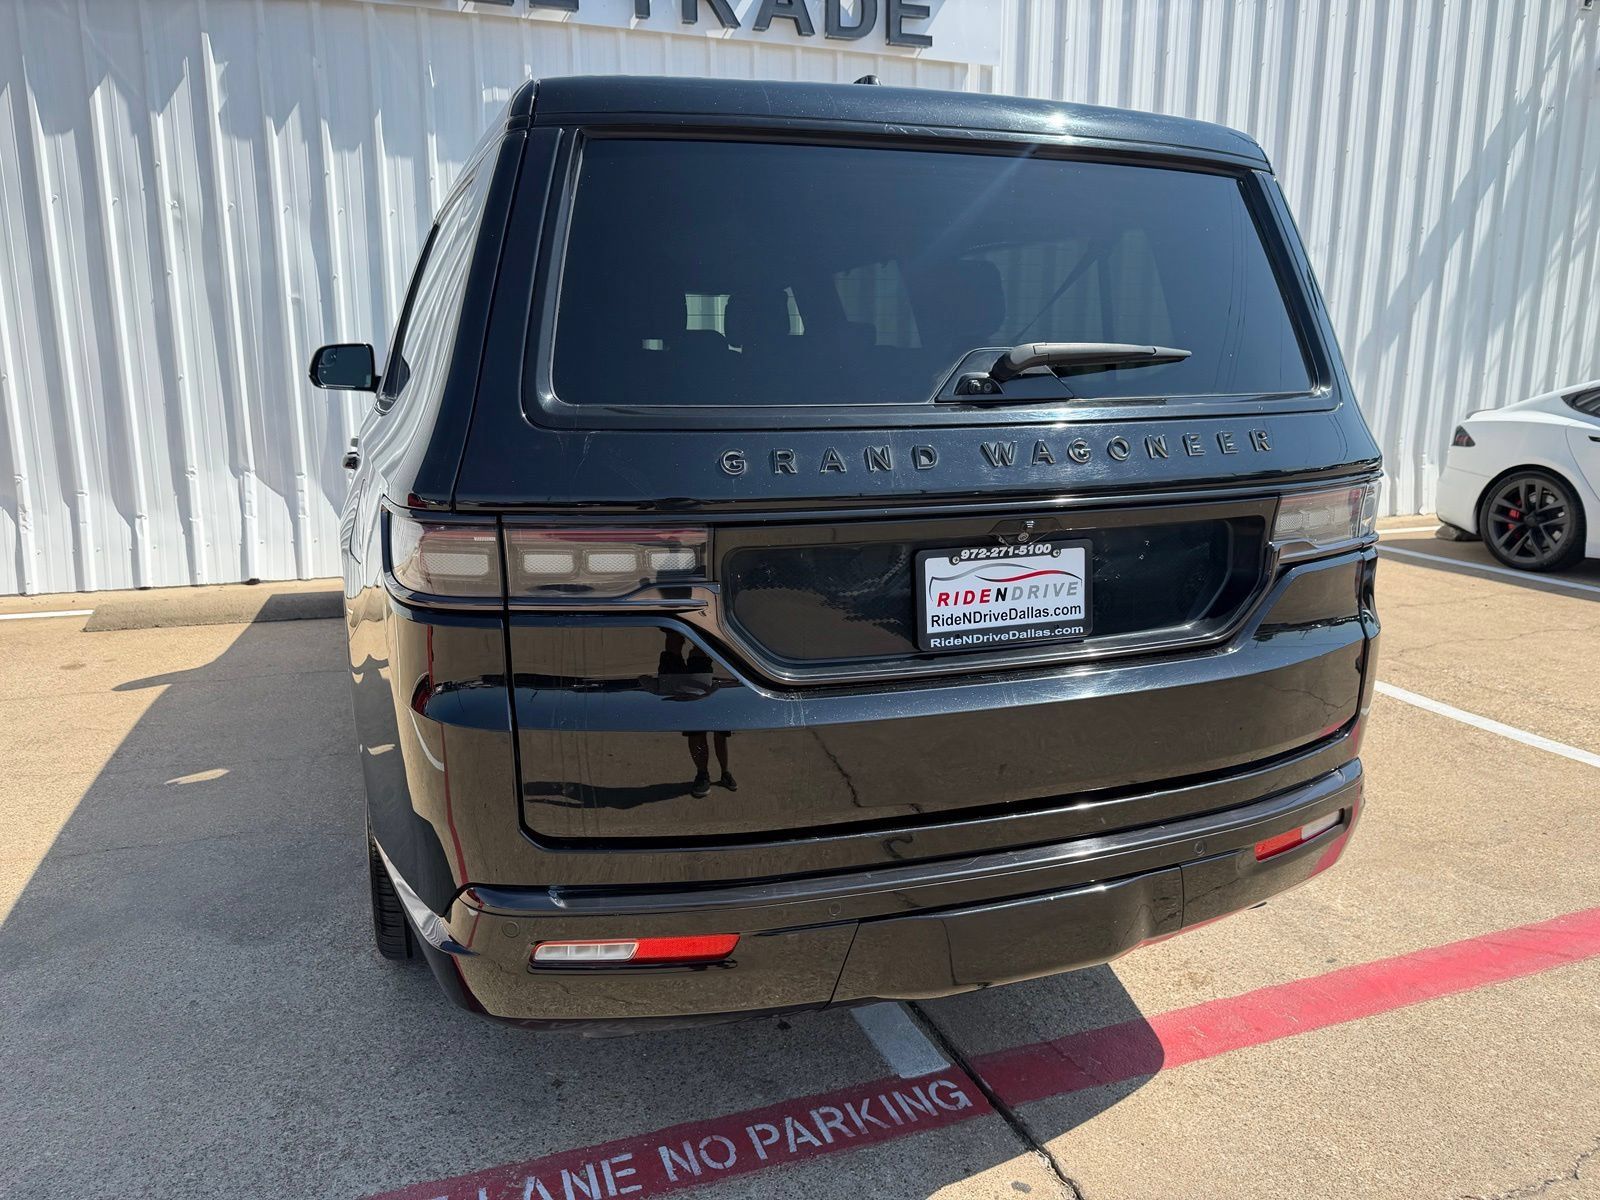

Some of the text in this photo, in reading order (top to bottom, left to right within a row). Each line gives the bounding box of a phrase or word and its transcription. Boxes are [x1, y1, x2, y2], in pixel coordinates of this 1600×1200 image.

[719, 429, 1273, 475] GRAND WAGONEER
[960, 543, 1052, 560] 972-271-5100
[931, 604, 1082, 628] RideNDriveDallas.com
[930, 625, 1084, 648] RideNDriveDallas.com
[658, 1134, 737, 1182] NO
[746, 1079, 973, 1160] PARKING
